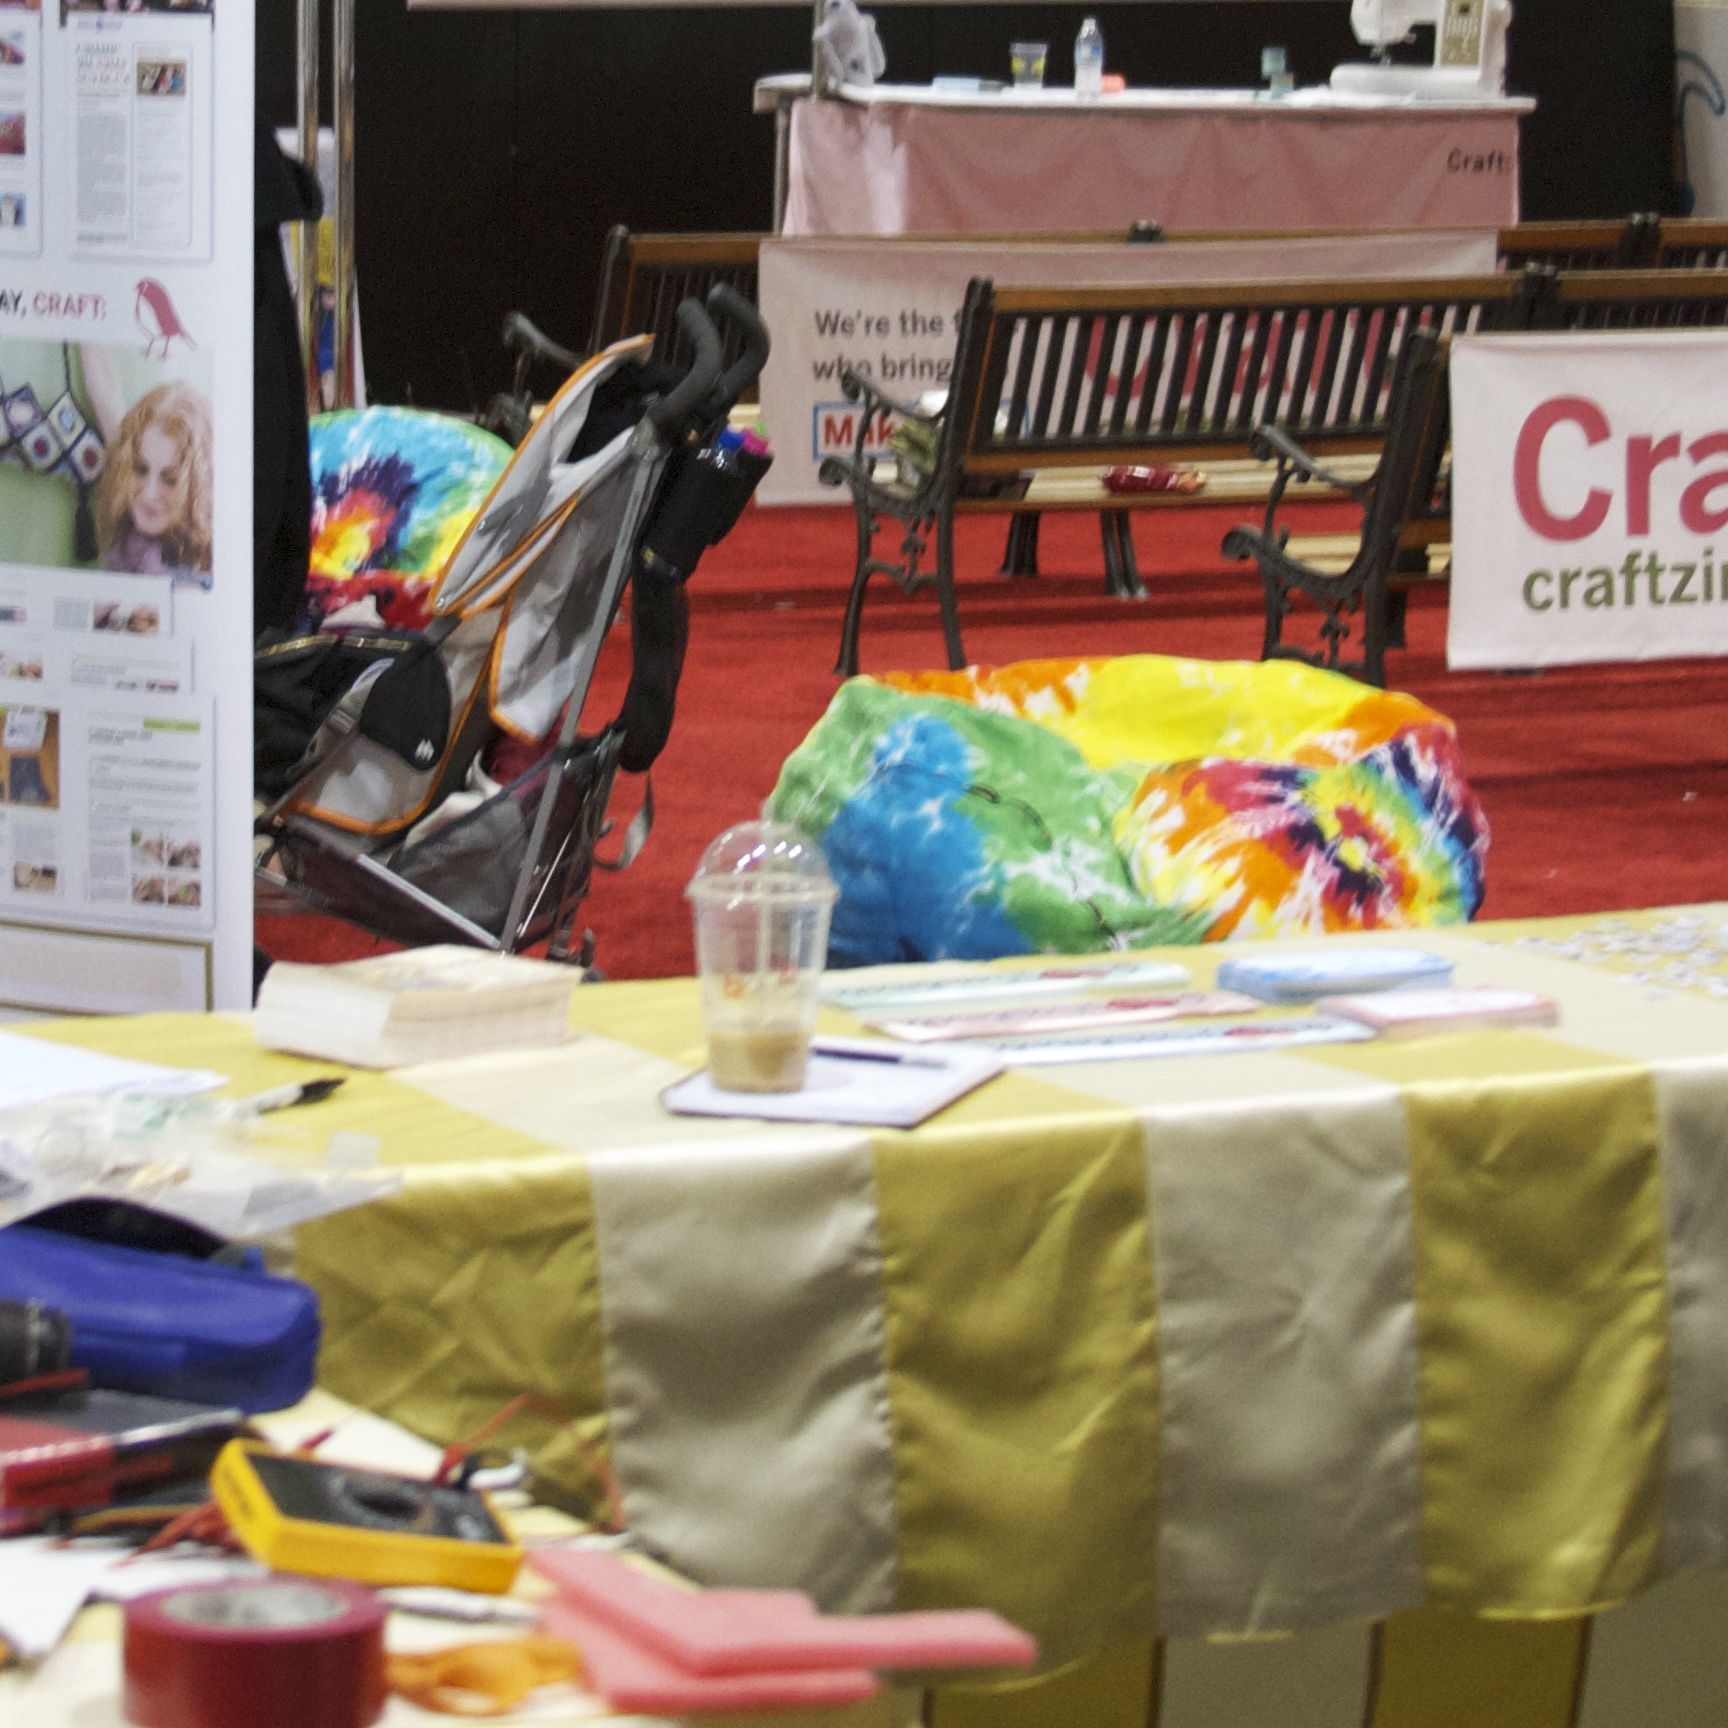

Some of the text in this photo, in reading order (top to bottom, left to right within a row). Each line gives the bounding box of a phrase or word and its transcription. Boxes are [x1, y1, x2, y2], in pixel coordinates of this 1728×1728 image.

[814, 308, 895, 338] We're
[900, 309, 945, 336] the
[813, 352, 954, 385] who bring
